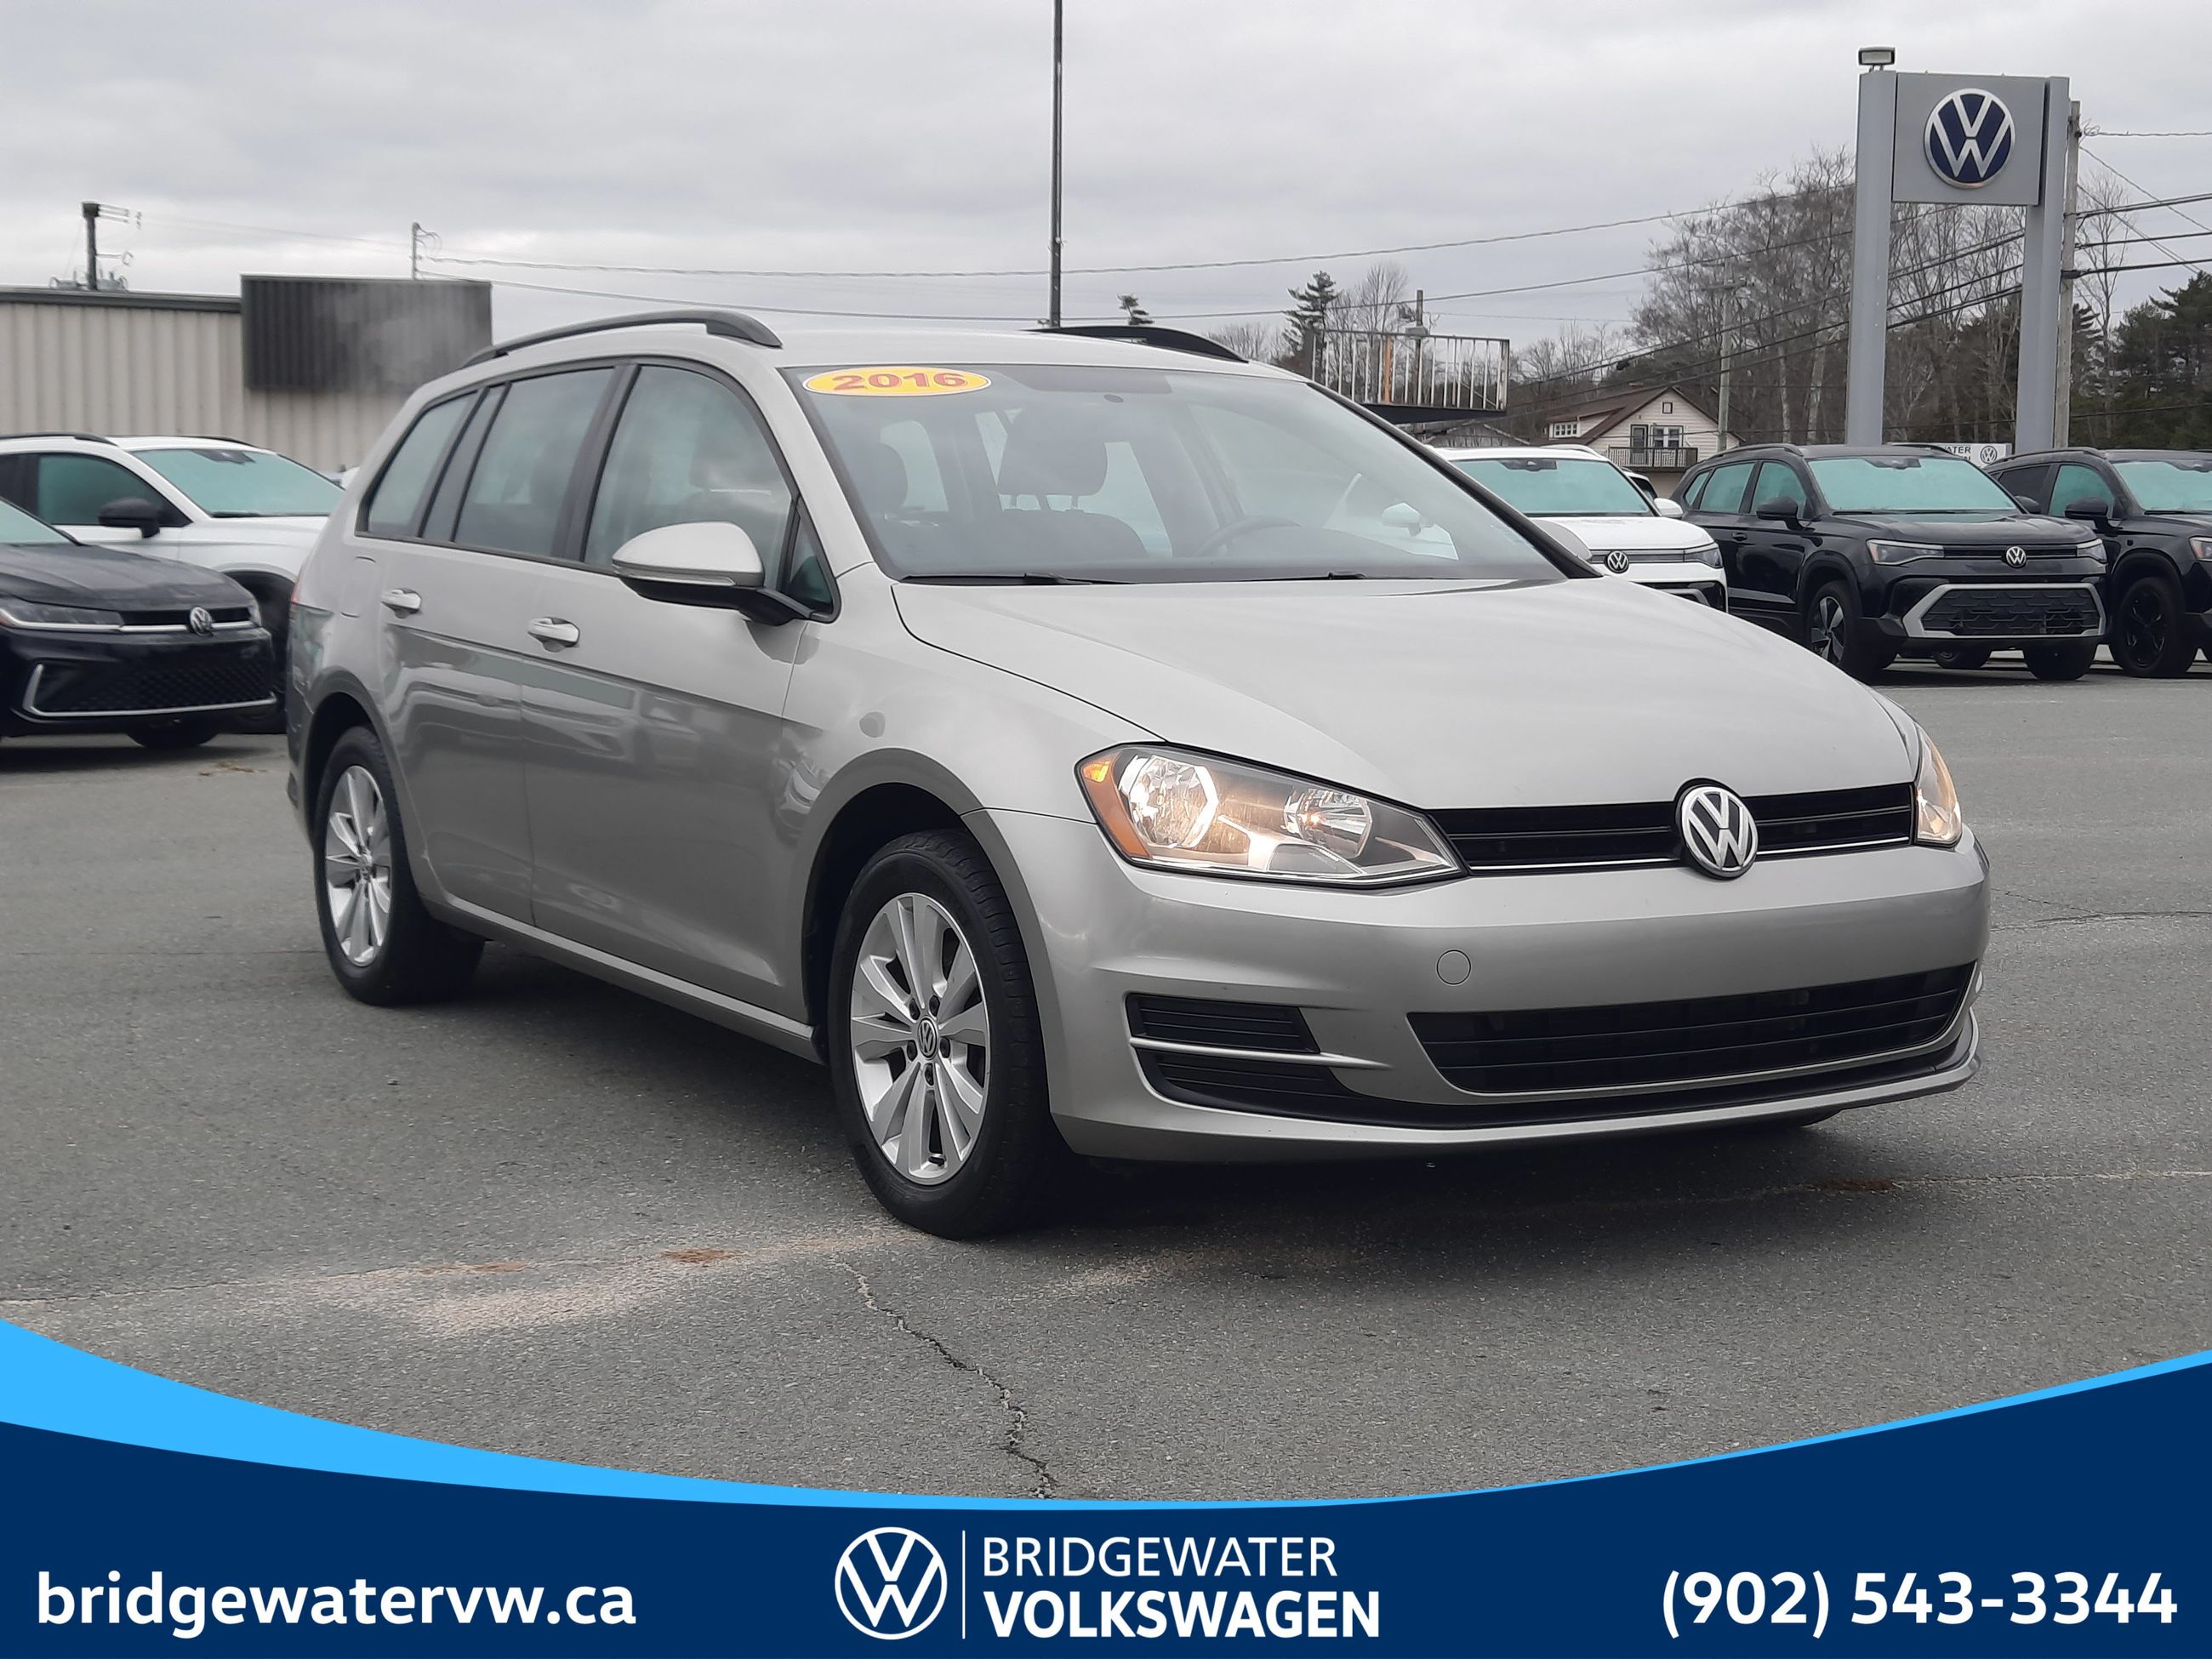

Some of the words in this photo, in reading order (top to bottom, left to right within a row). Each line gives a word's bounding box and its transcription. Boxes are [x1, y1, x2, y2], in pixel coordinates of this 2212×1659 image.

[1924, 88, 2015, 189] VW
[832, 372, 967, 391] 2016
[1607, 550, 1629, 573] VW
[2006, 546, 2027, 567] VW
[1681, 786, 1759, 873] VW
